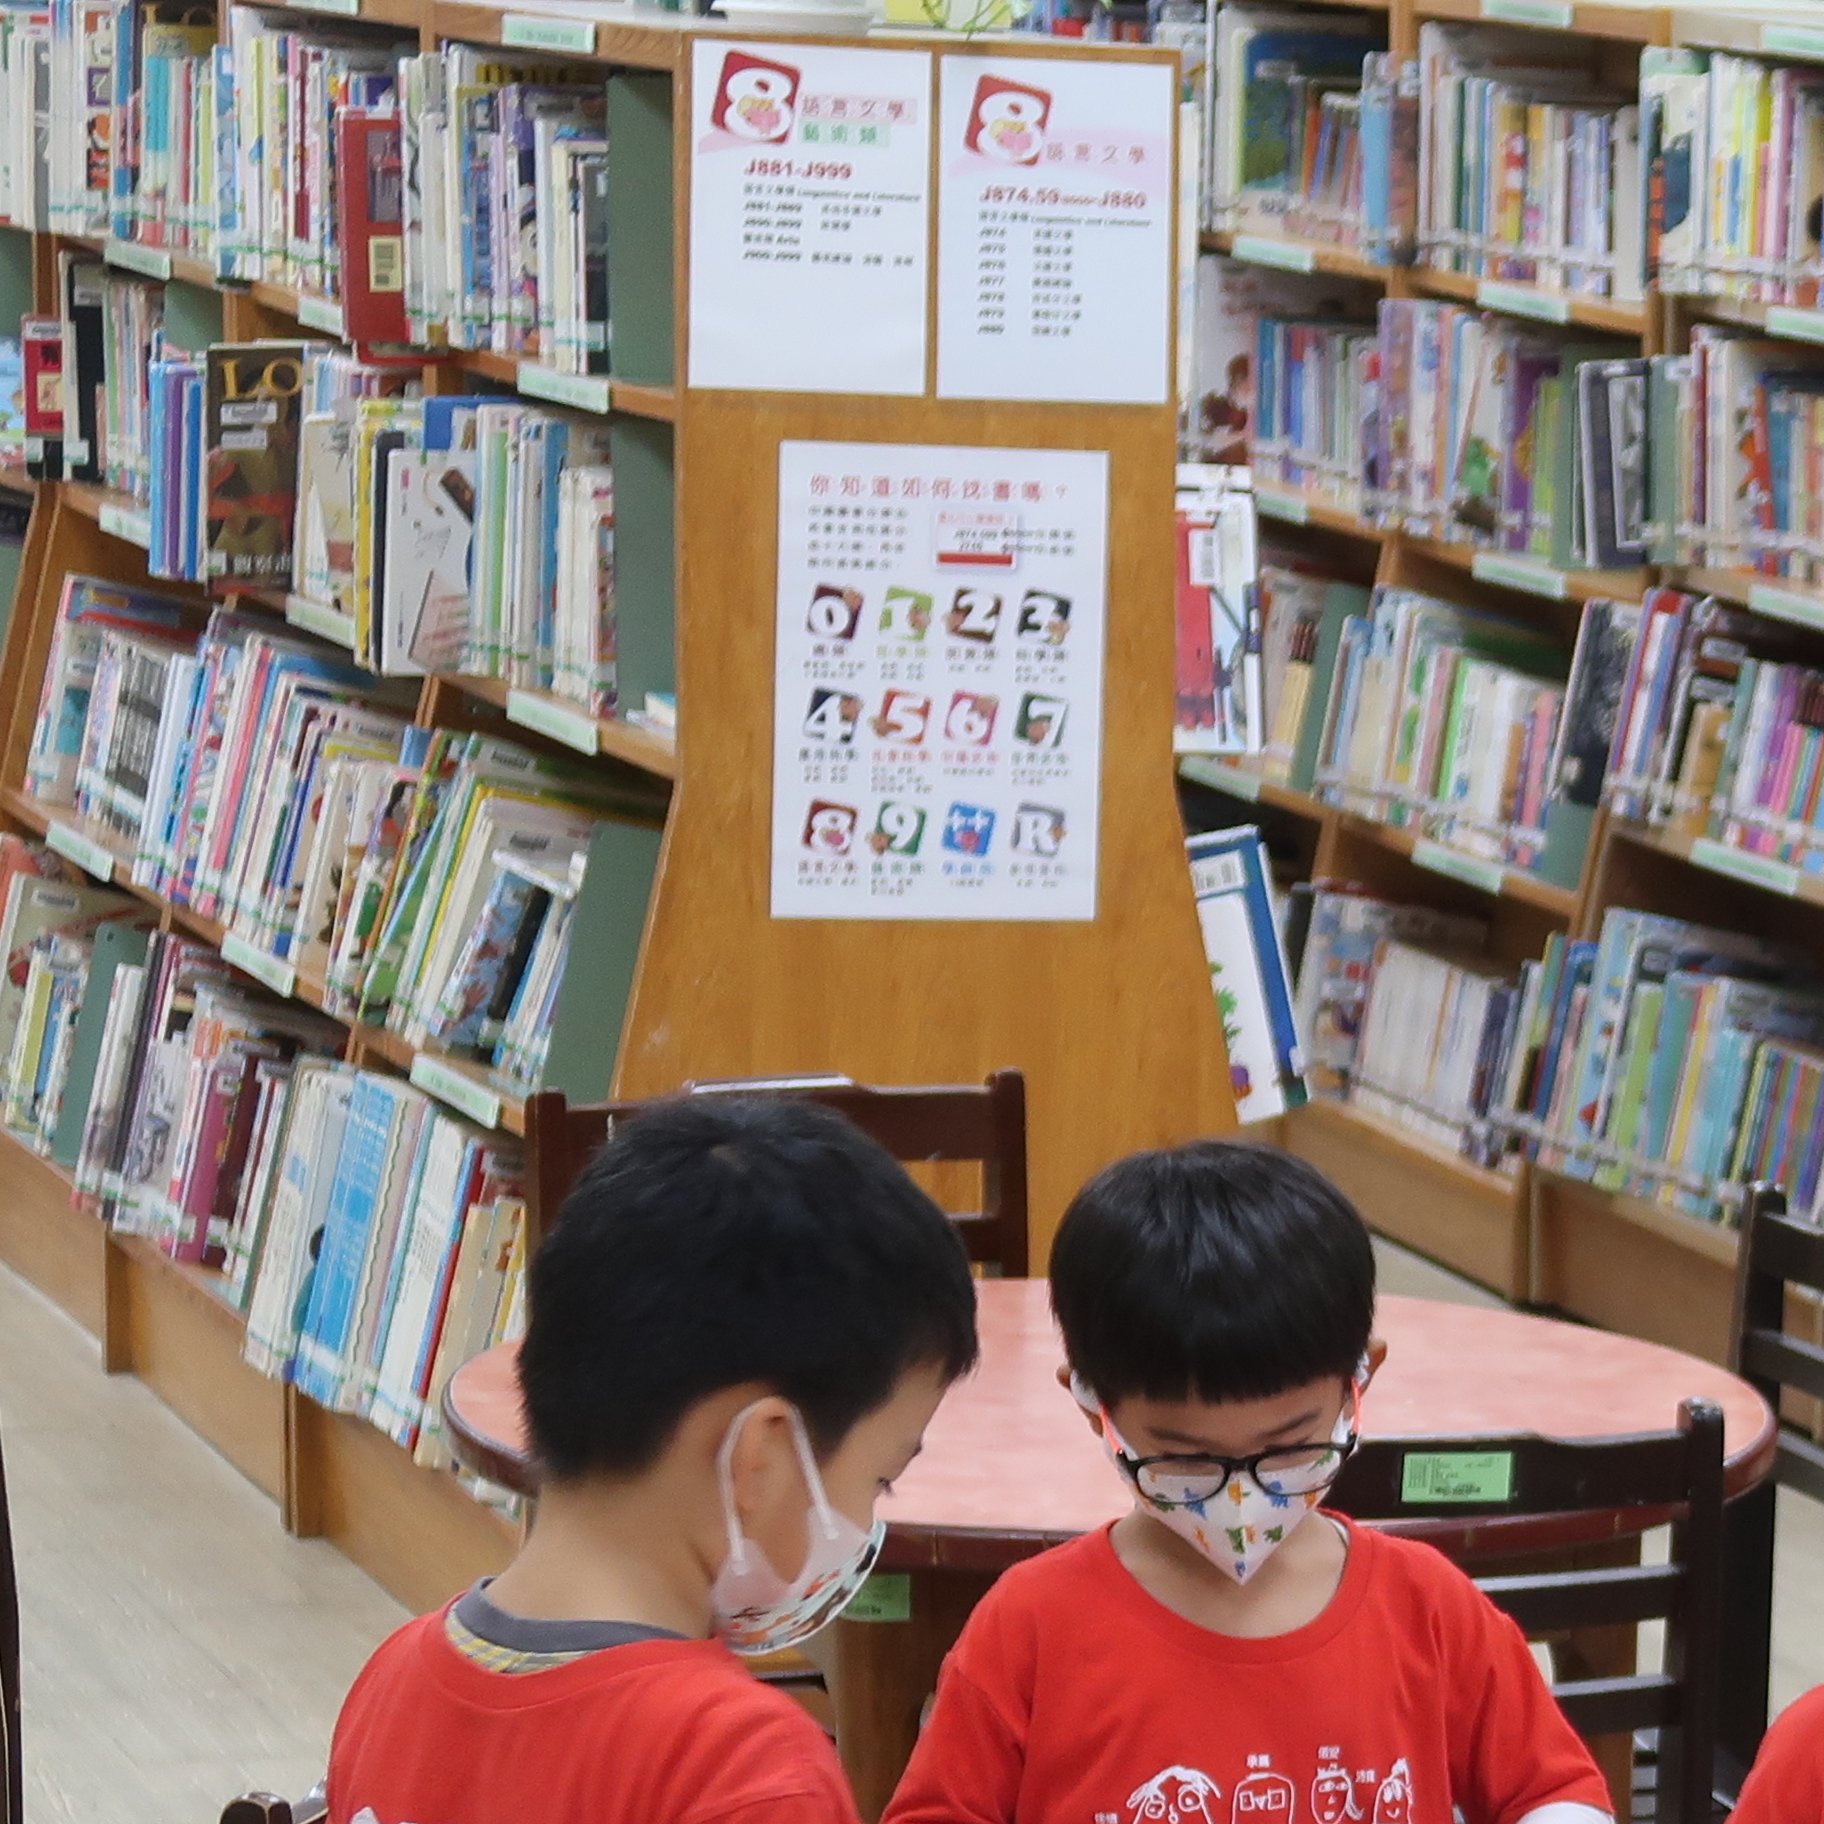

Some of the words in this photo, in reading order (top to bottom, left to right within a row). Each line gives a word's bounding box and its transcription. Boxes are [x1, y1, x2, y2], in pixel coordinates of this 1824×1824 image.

[802, 96, 905, 120] 語言文學
[744, 158, 853, 180] J881-J999
